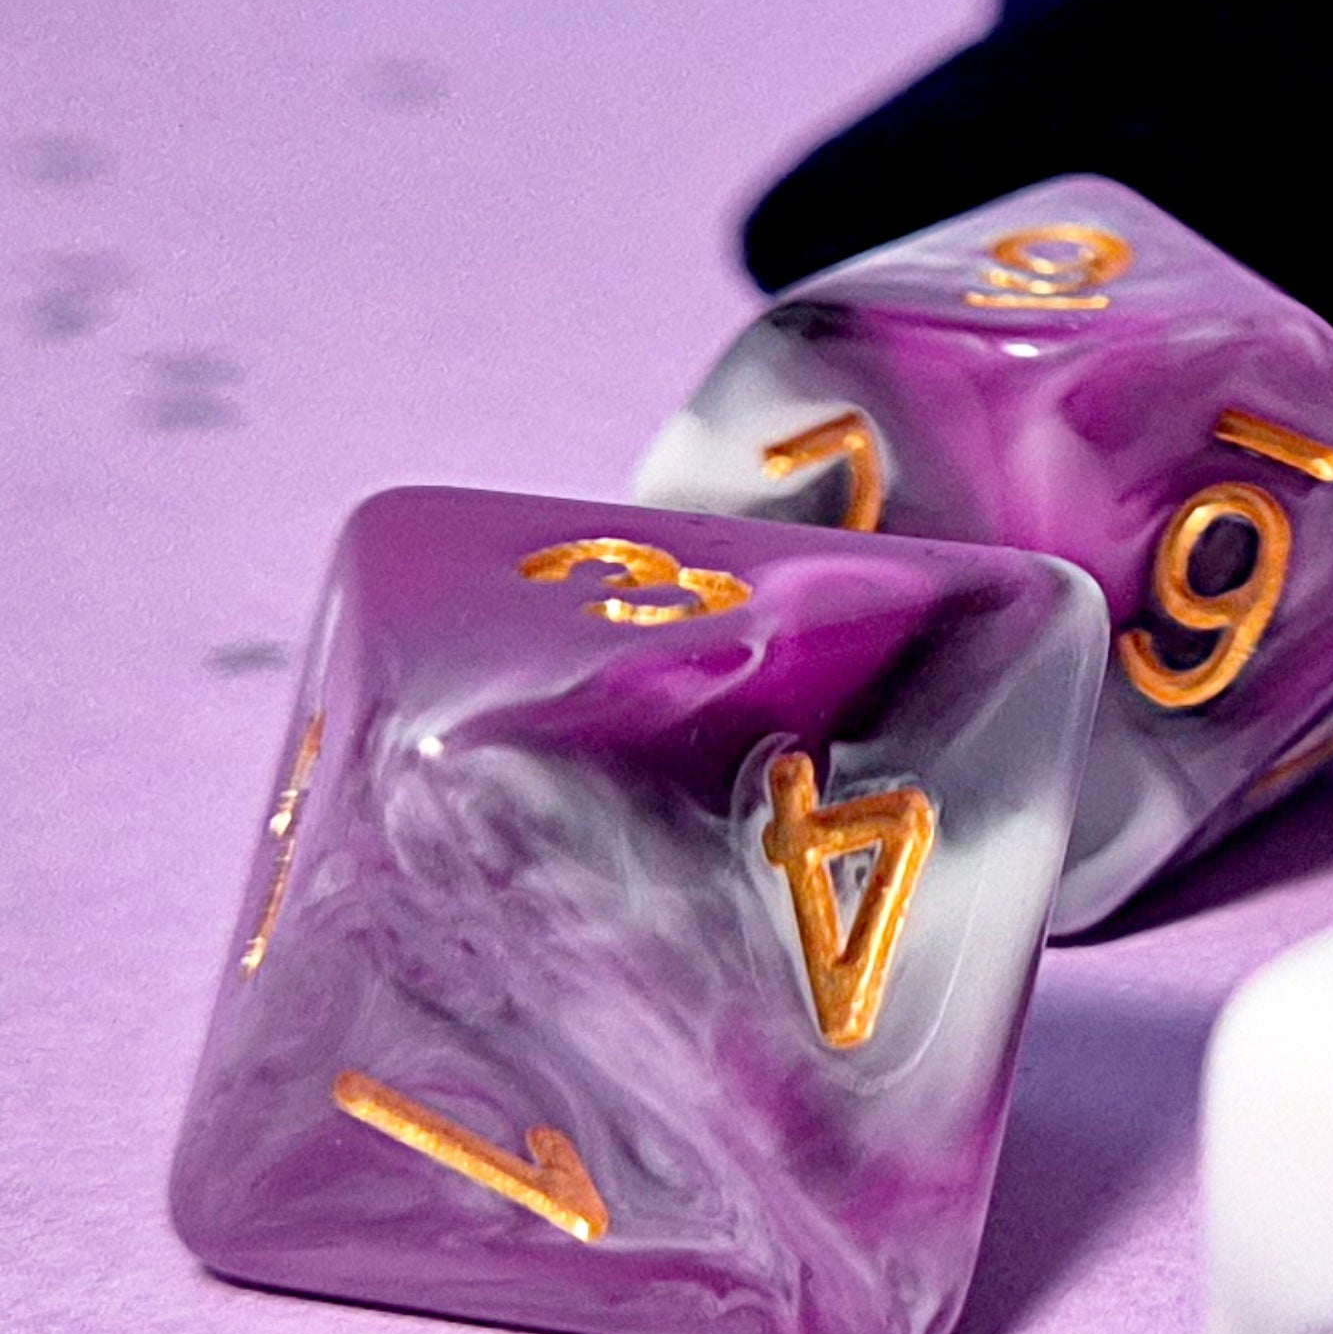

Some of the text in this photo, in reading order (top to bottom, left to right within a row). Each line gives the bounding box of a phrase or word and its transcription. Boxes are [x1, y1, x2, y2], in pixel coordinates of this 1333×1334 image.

[517, 535, 754, 627] 3
[760, 750, 938, 1050] 4
[331, 1067, 610, 1244] 1
